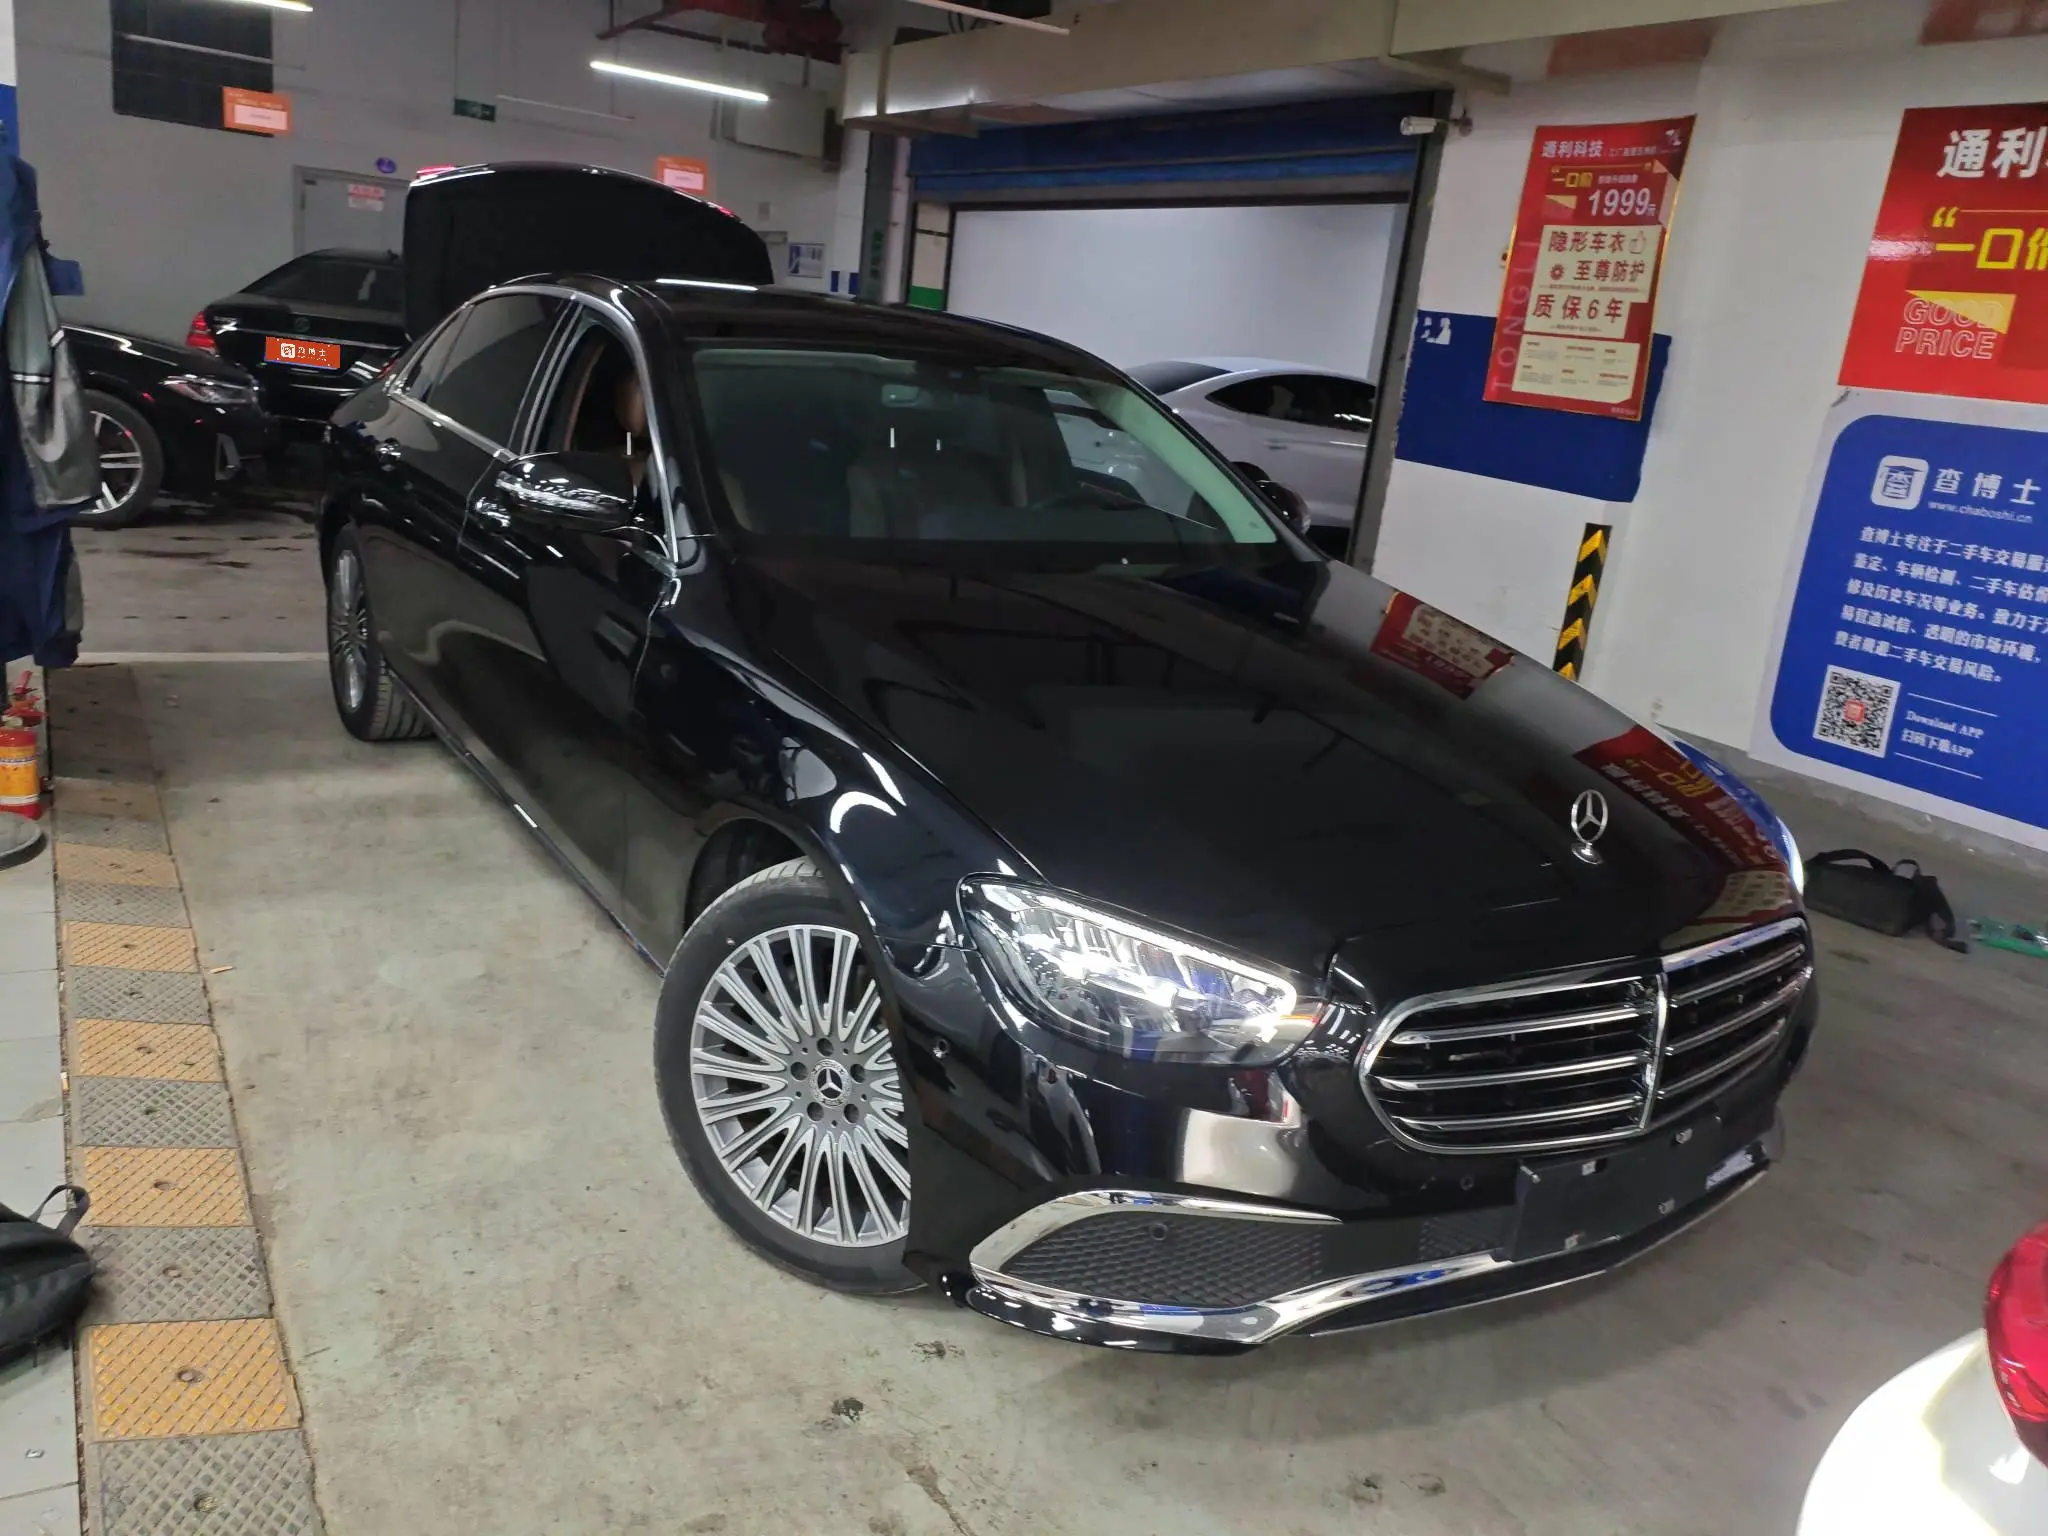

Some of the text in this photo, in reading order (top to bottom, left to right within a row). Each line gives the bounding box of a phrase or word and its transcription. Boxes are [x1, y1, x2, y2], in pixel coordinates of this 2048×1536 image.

[1542, 139, 1604, 158] 通利科技
[1936, 126, 2048, 178] 通利
[1548, 230, 1627, 253] 隐形车衣
[1573, 259, 1646, 282] 至尊防护
[1895, 326, 1998, 360] PRICE
[1932, 467, 2042, 505] 查博士
[1958, 724, 1985, 739] APP
